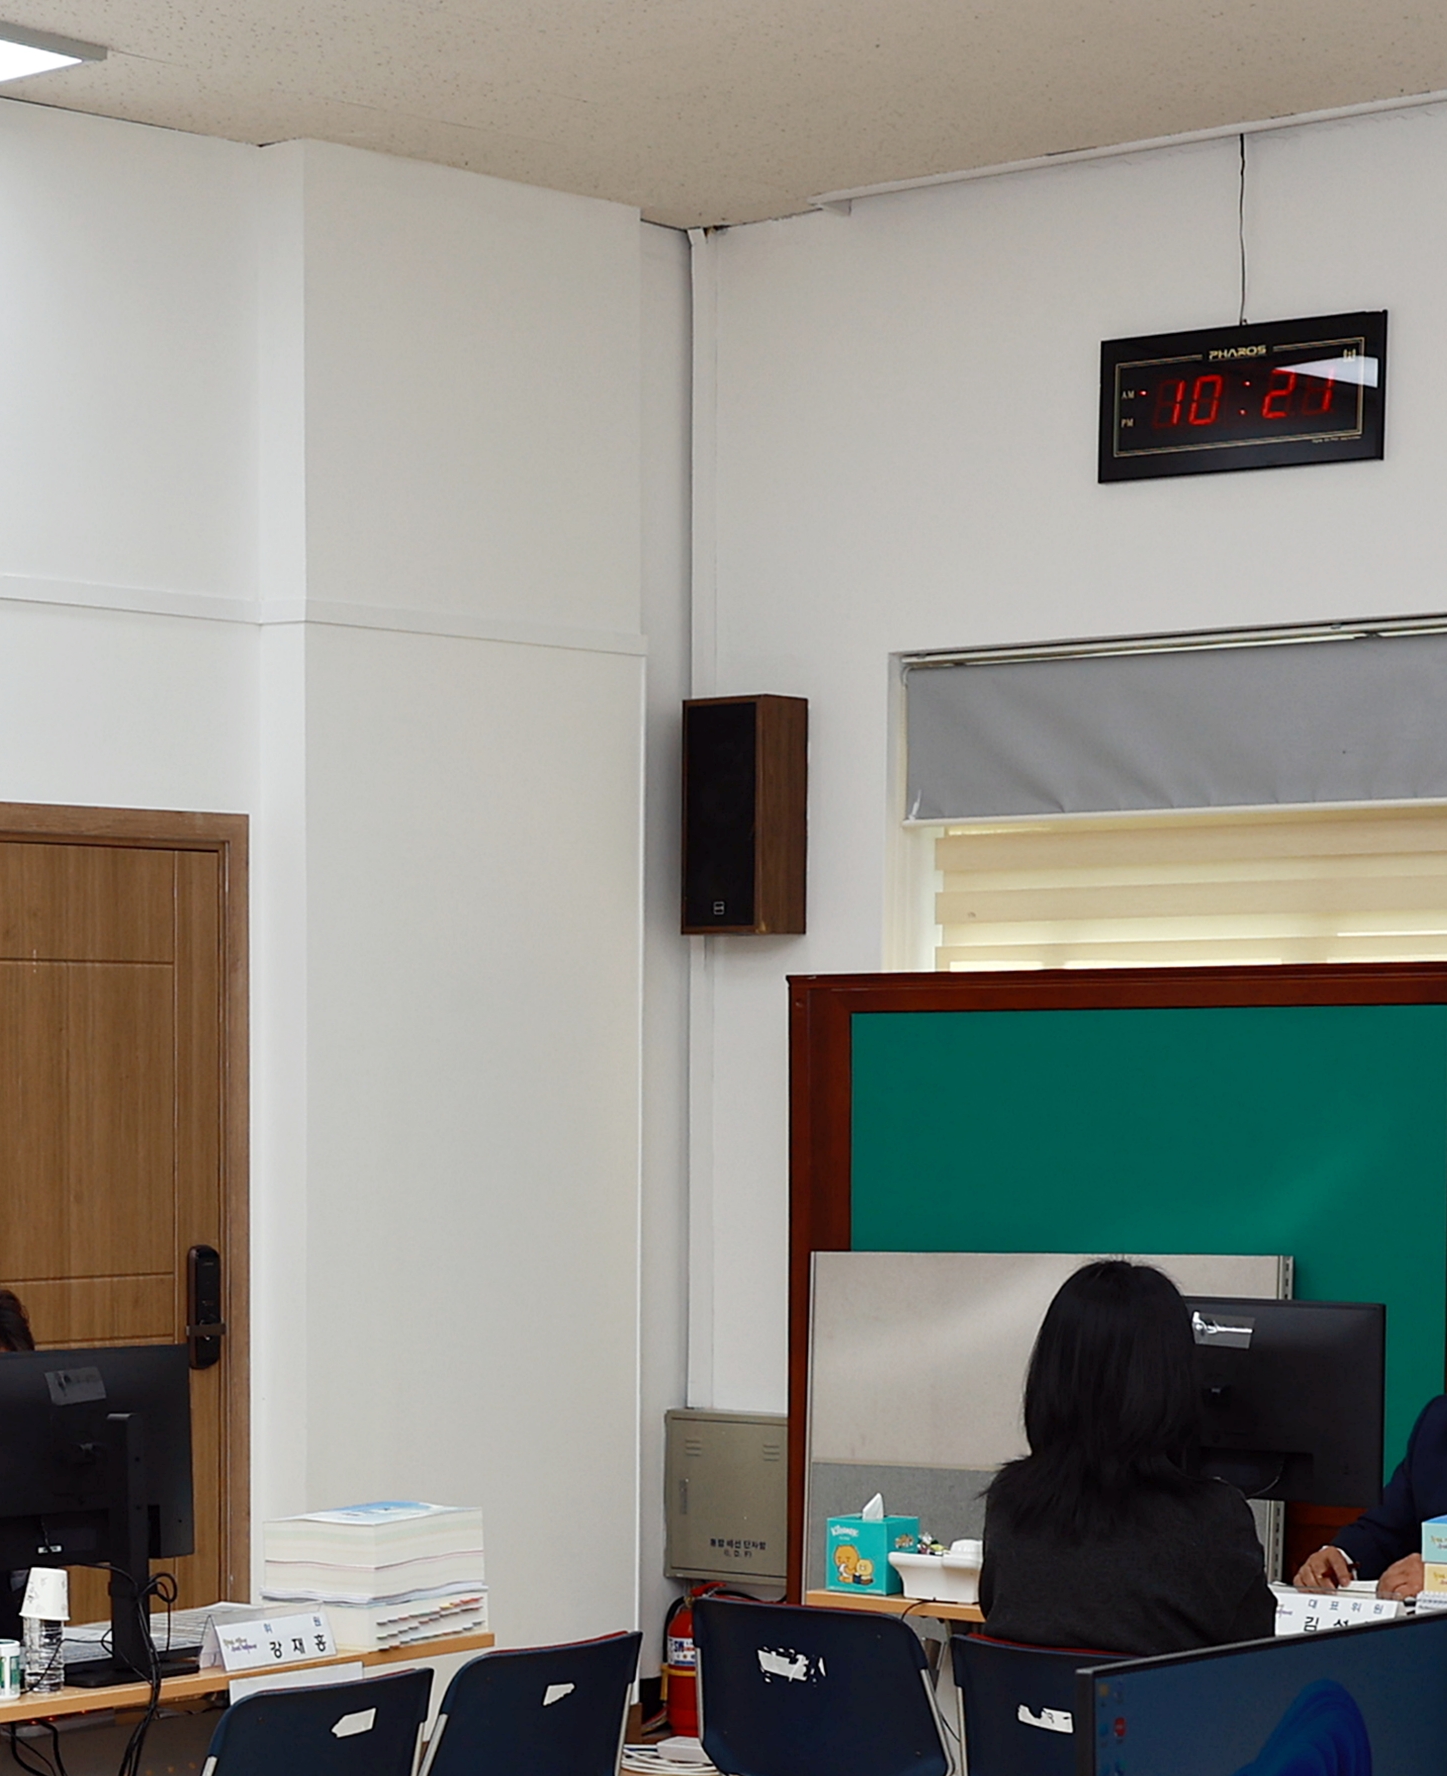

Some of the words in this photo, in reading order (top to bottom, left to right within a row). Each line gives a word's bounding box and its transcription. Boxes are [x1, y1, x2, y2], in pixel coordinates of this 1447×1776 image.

[1208, 345, 1267, 360] PHAROS
[1121, 390, 1135, 400] AM
[1121, 417, 1135, 428] PM
[269, 1634, 327, 1659] 강재홍
